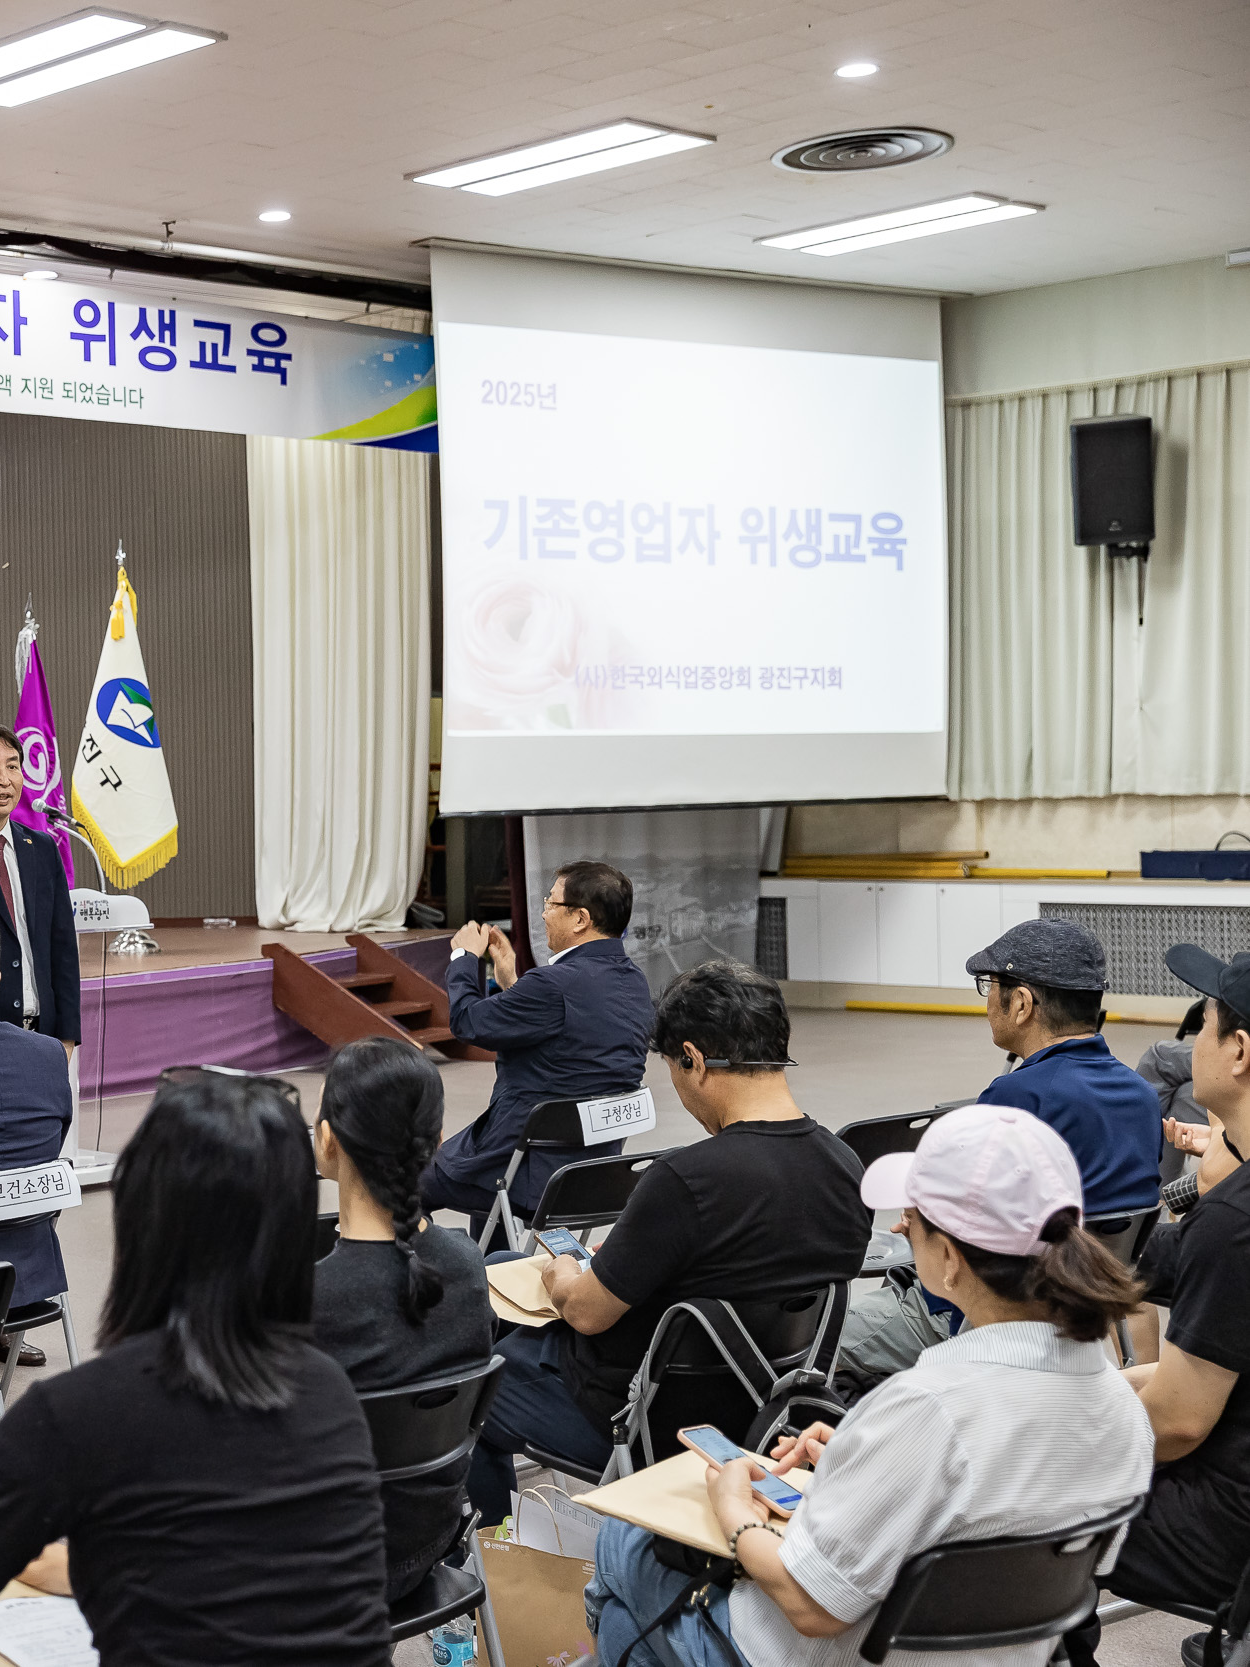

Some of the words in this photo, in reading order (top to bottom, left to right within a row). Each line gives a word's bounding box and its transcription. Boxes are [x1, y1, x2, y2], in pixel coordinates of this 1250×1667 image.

[70, 299, 293, 386] 위생교육
[20, 377, 55, 401] 지원
[61, 380, 145, 409] 되었습니다
[480, 379, 558, 411] 2025년
[483, 495, 721, 565] 기존영업자
[737, 505, 908, 571] 위생교육
[573, 663, 752, 691] (사)한국외식업중앙회
[758, 665, 844, 691] 광진구지회
[601, 1100, 642, 1125] 구청장님
